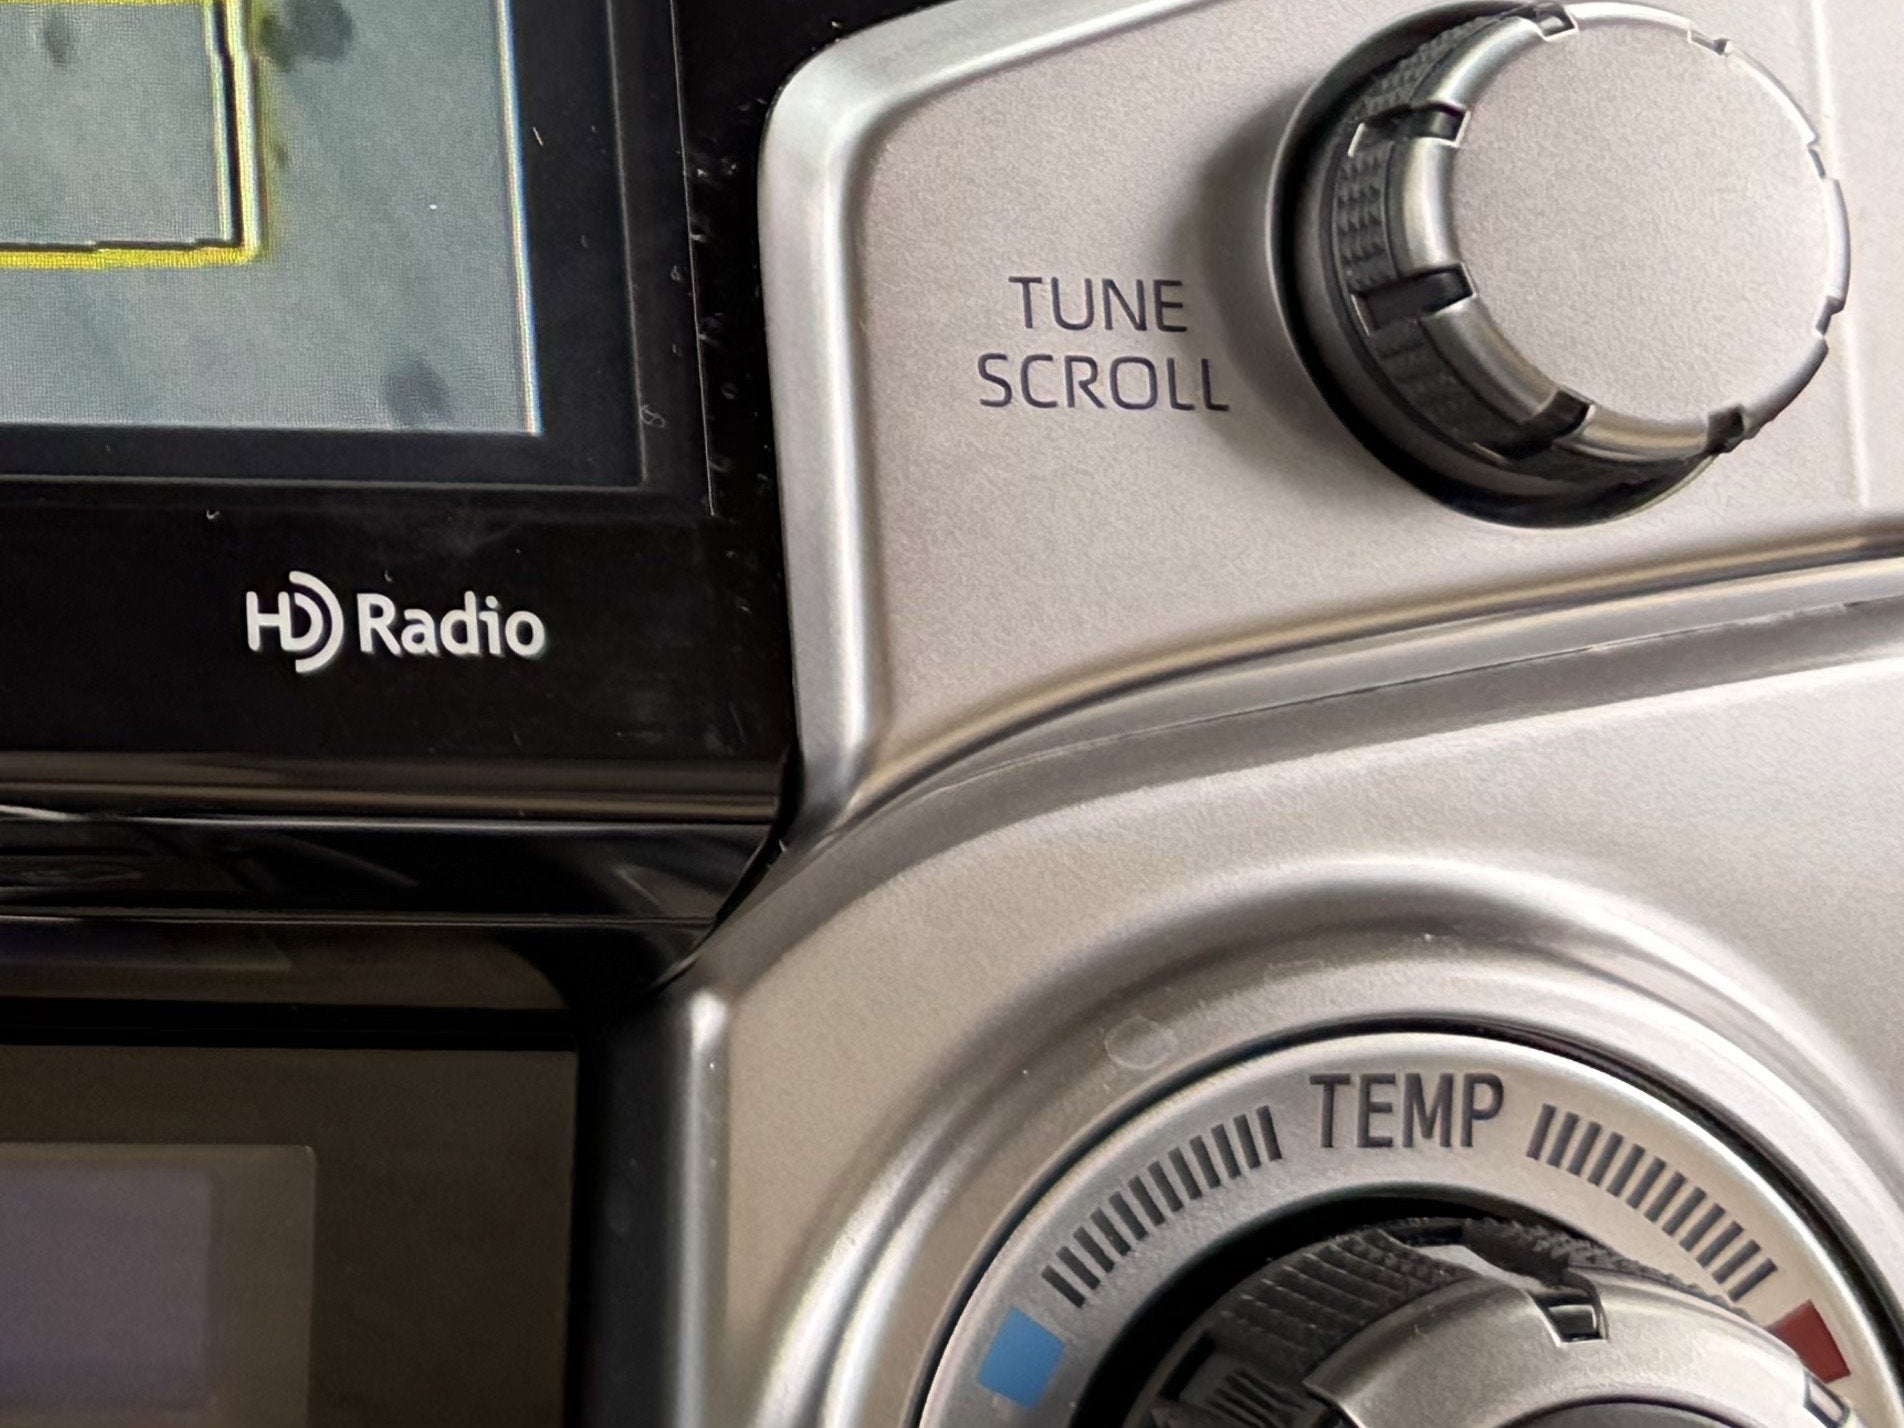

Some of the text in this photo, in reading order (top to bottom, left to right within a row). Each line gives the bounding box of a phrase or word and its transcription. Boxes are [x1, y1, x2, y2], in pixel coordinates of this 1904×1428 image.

[1007, 275, 1189, 334] TUNE
[976, 351, 1231, 413] SCROLL
[244, 569, 547, 675] HD Radio
[1307, 1072, 1506, 1150] TEMP
